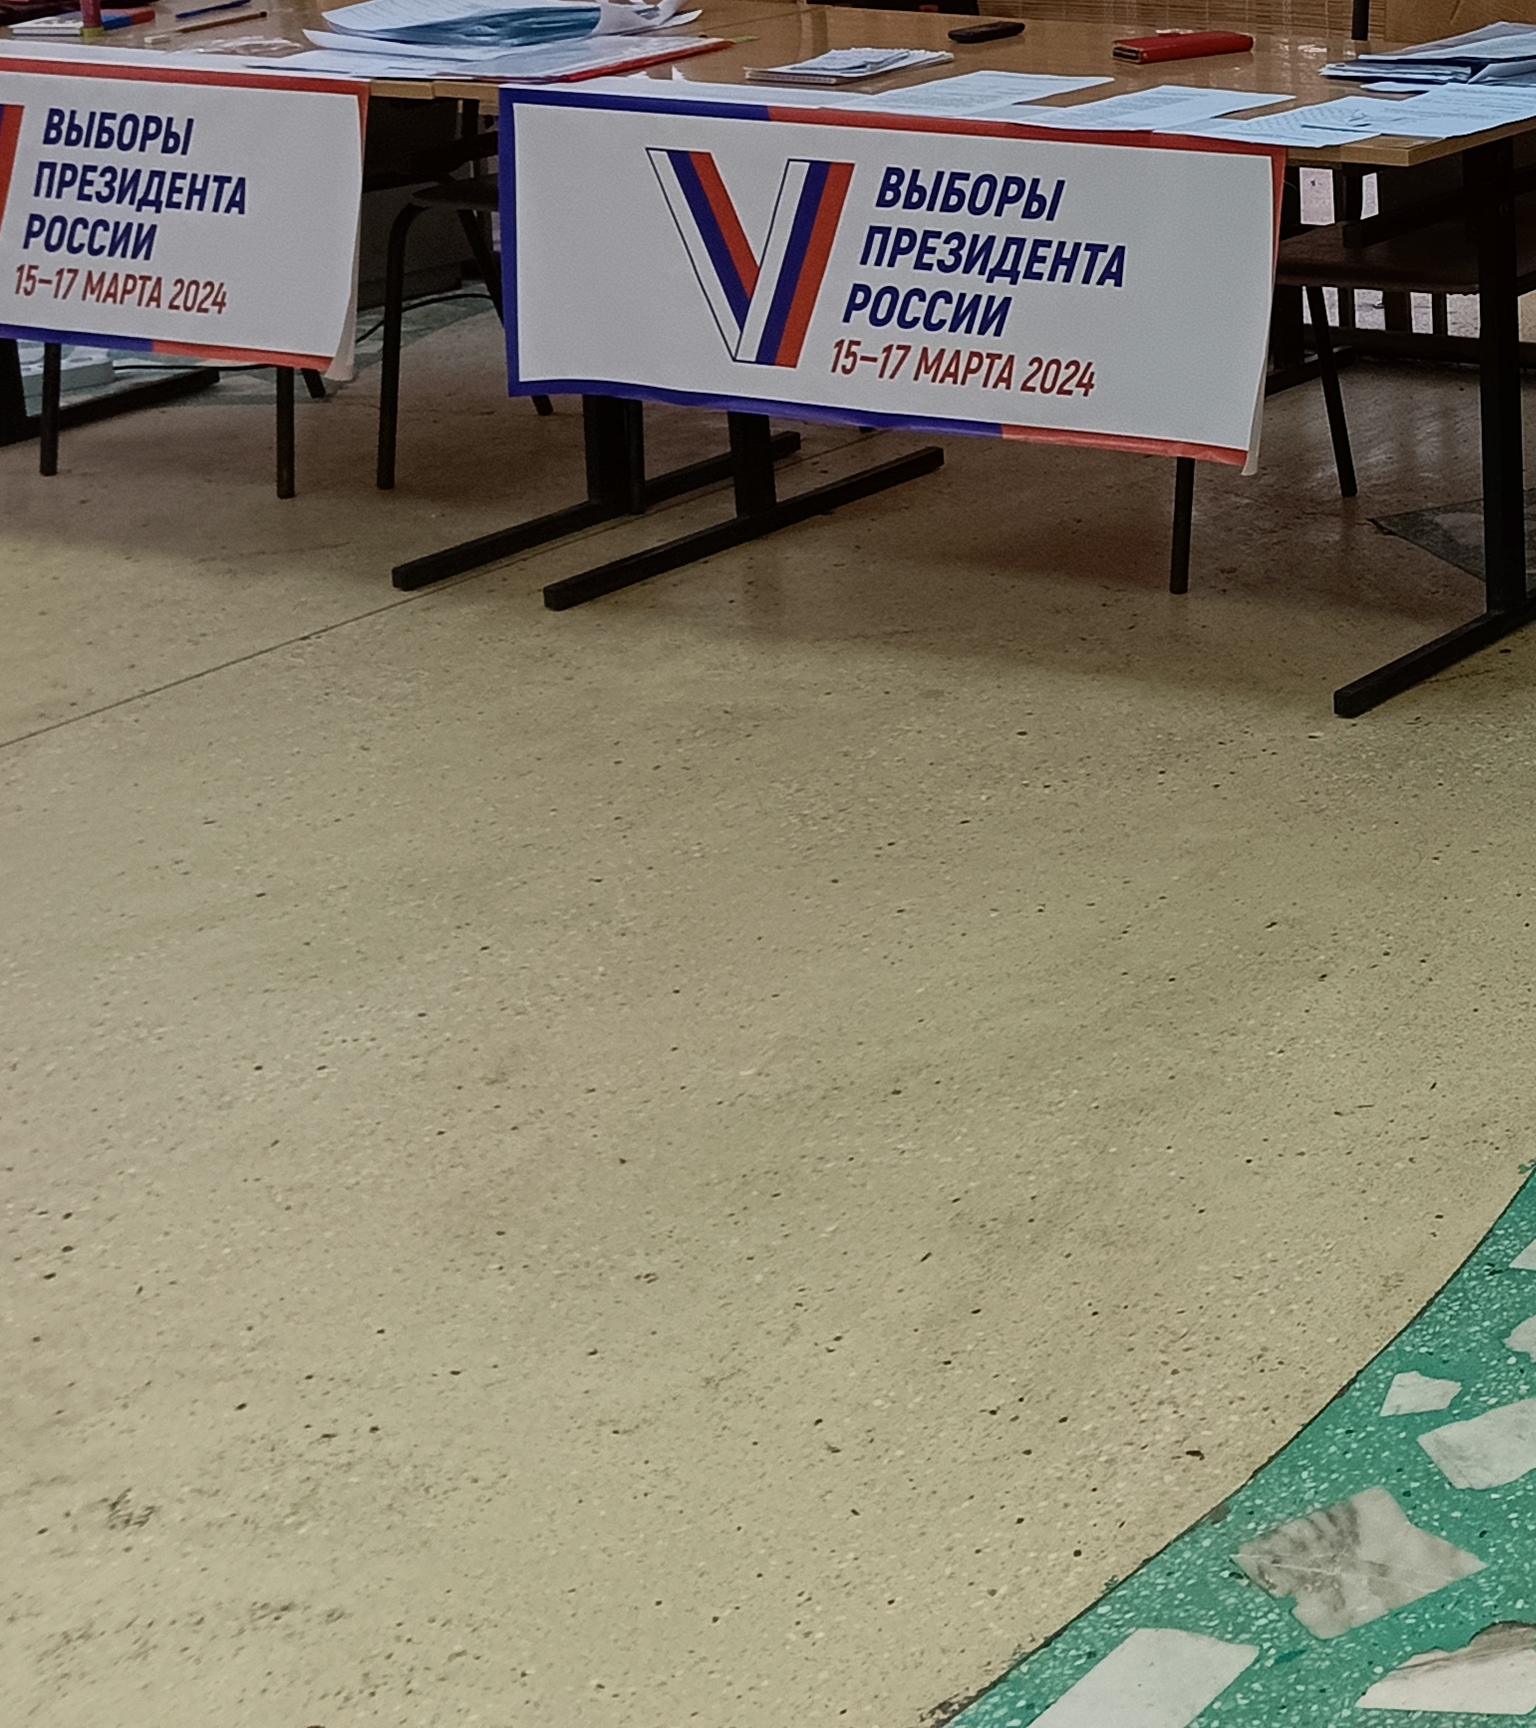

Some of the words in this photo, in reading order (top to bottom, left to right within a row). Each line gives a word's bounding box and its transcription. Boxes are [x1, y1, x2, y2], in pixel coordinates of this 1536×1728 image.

[42, 108, 194, 155] ВЫБОРЫ
[33, 161, 246, 215] ПРЕЗИДЕНТА
[875, 167, 1065, 222] ВЫБОРЫ
[23, 213, 157, 260] РОССИИ
[859, 225, 1126, 287] ПРЕЗИДЕНТА
[81, 270, 163, 309] МАРТА
[168, 278, 227, 314] 2024
[843, 283, 1012, 338] РОССИИ
[915, 346, 1013, 390] МАРТА
[1021, 357, 1095, 397] 2024
